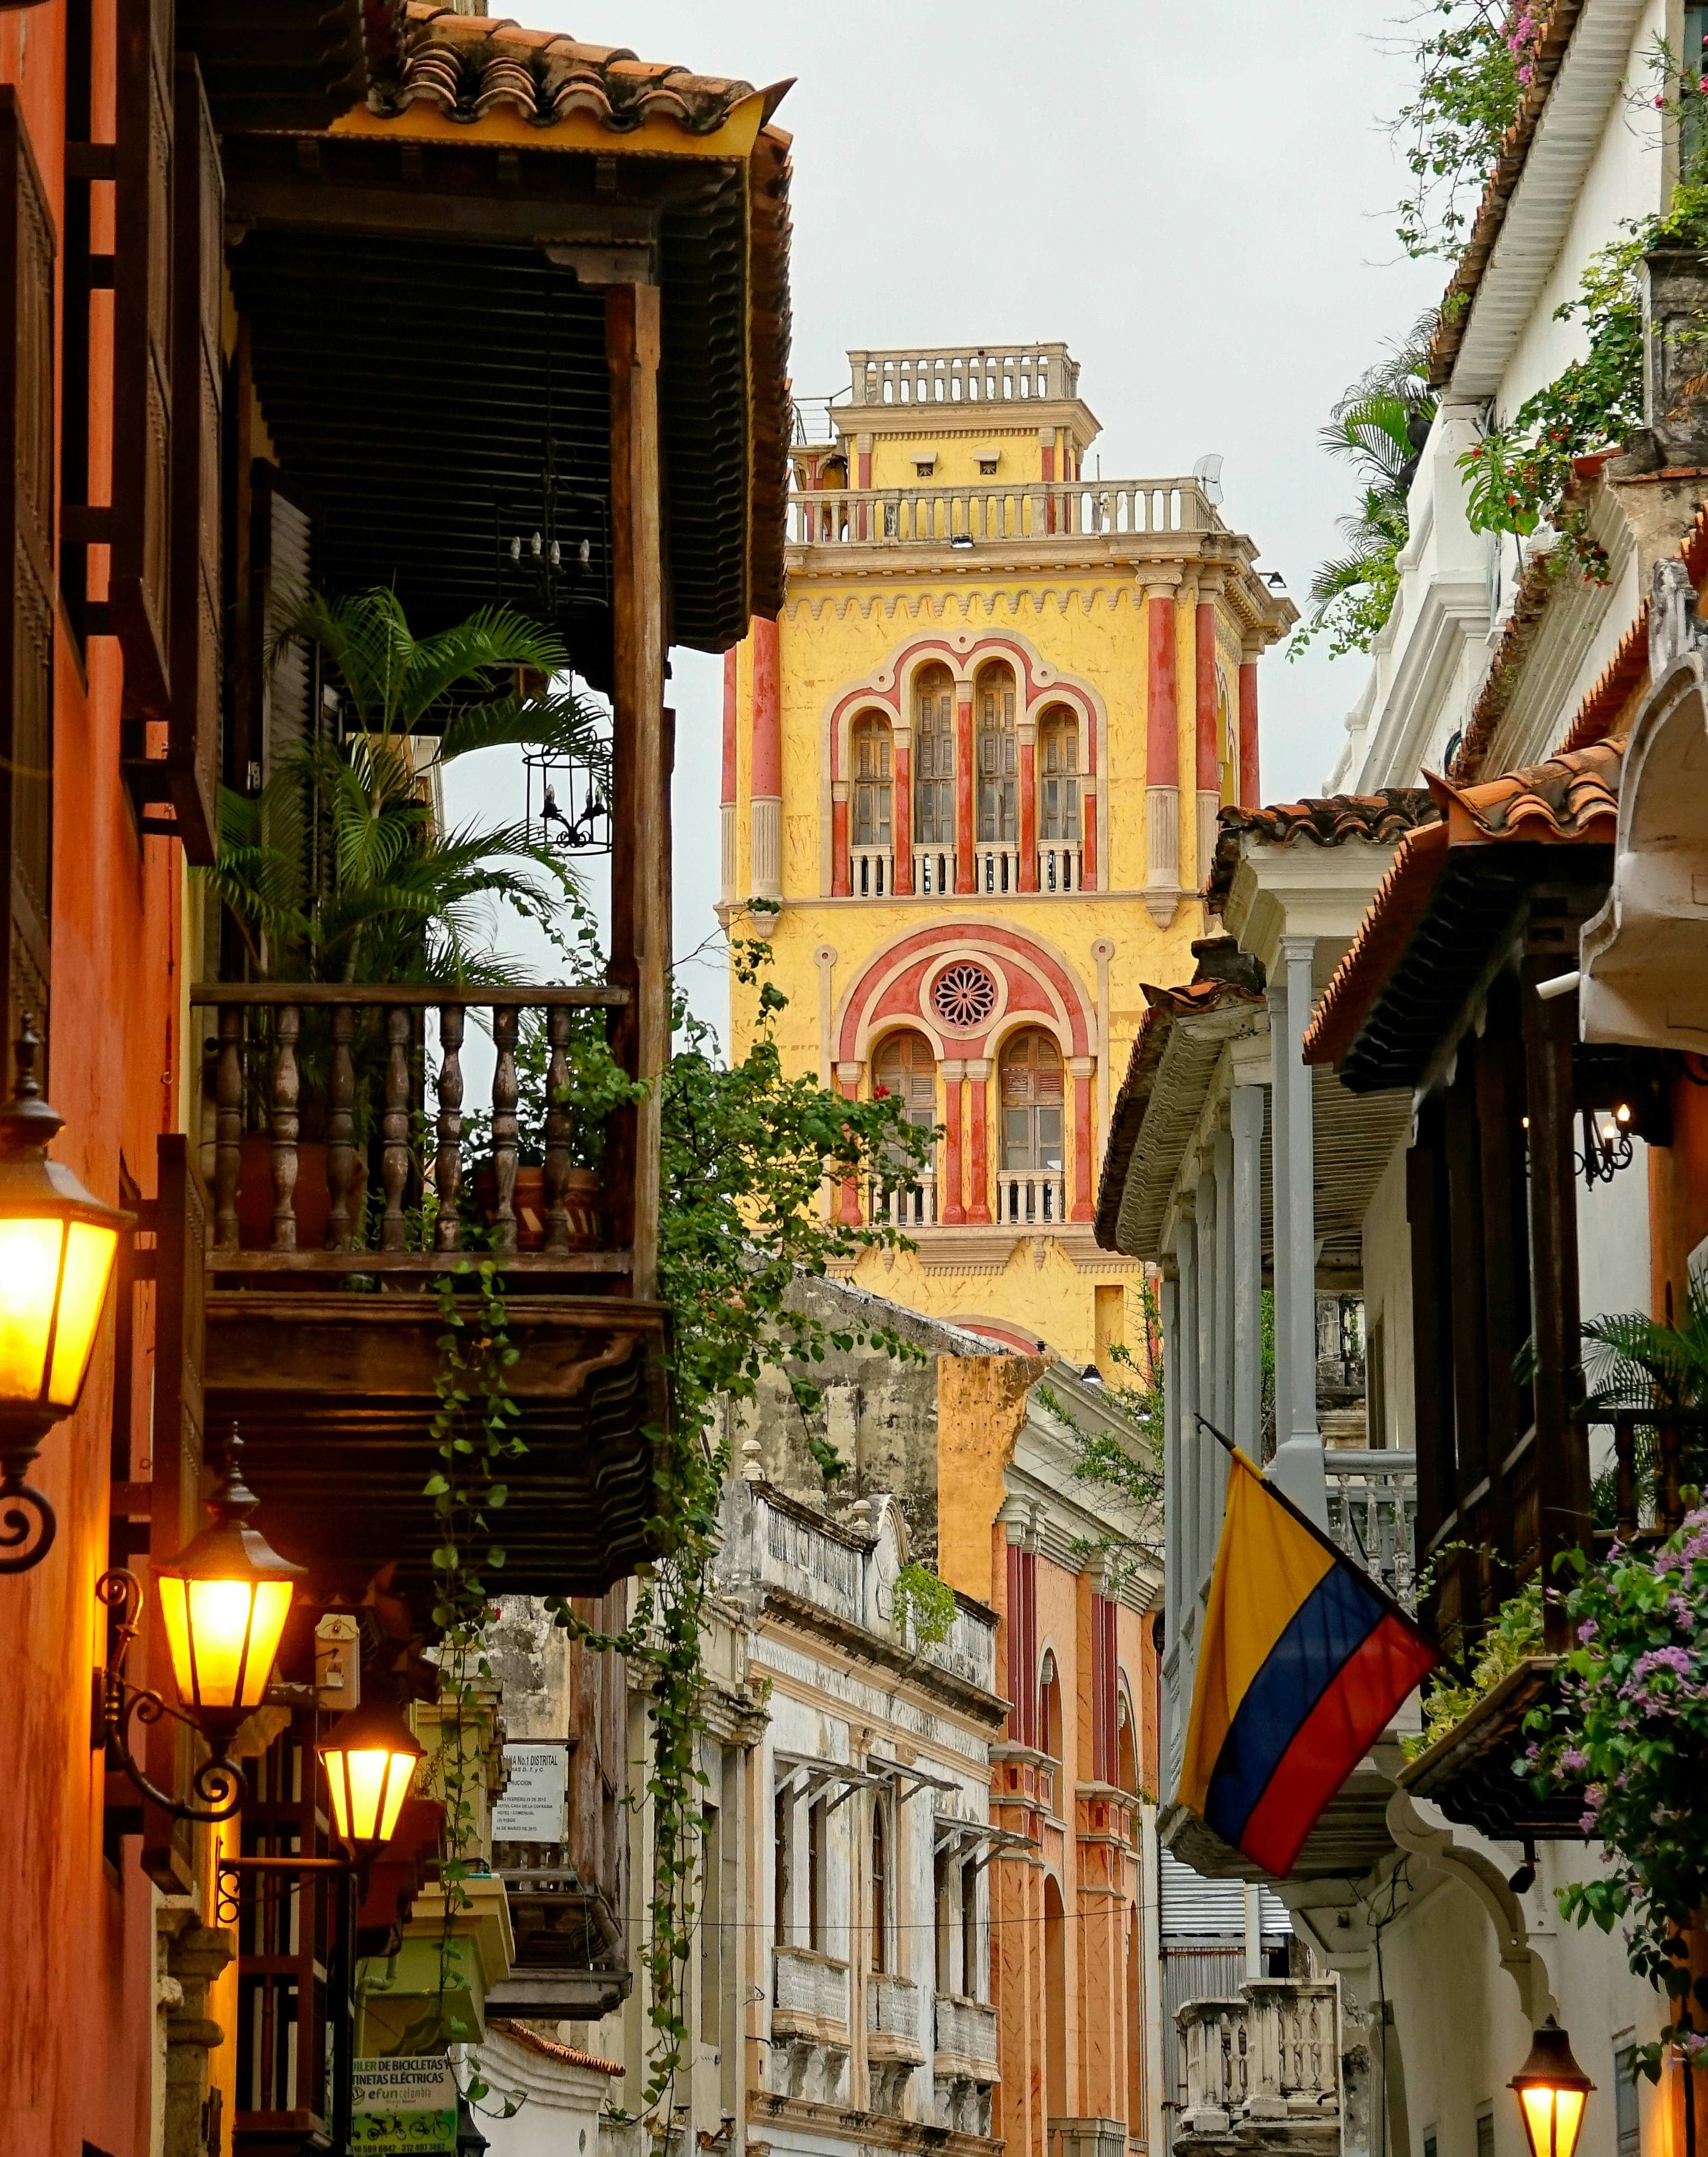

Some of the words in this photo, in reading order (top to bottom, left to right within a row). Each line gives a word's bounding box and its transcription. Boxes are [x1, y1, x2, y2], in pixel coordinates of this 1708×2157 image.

[530, 1754, 558, 1766] DISTRITAL
[379, 2060, 391, 2071] DE
[392, 2059, 443, 2071] BICICLETAS
[390, 2071, 444, 2084] ELÉCTRICAS
